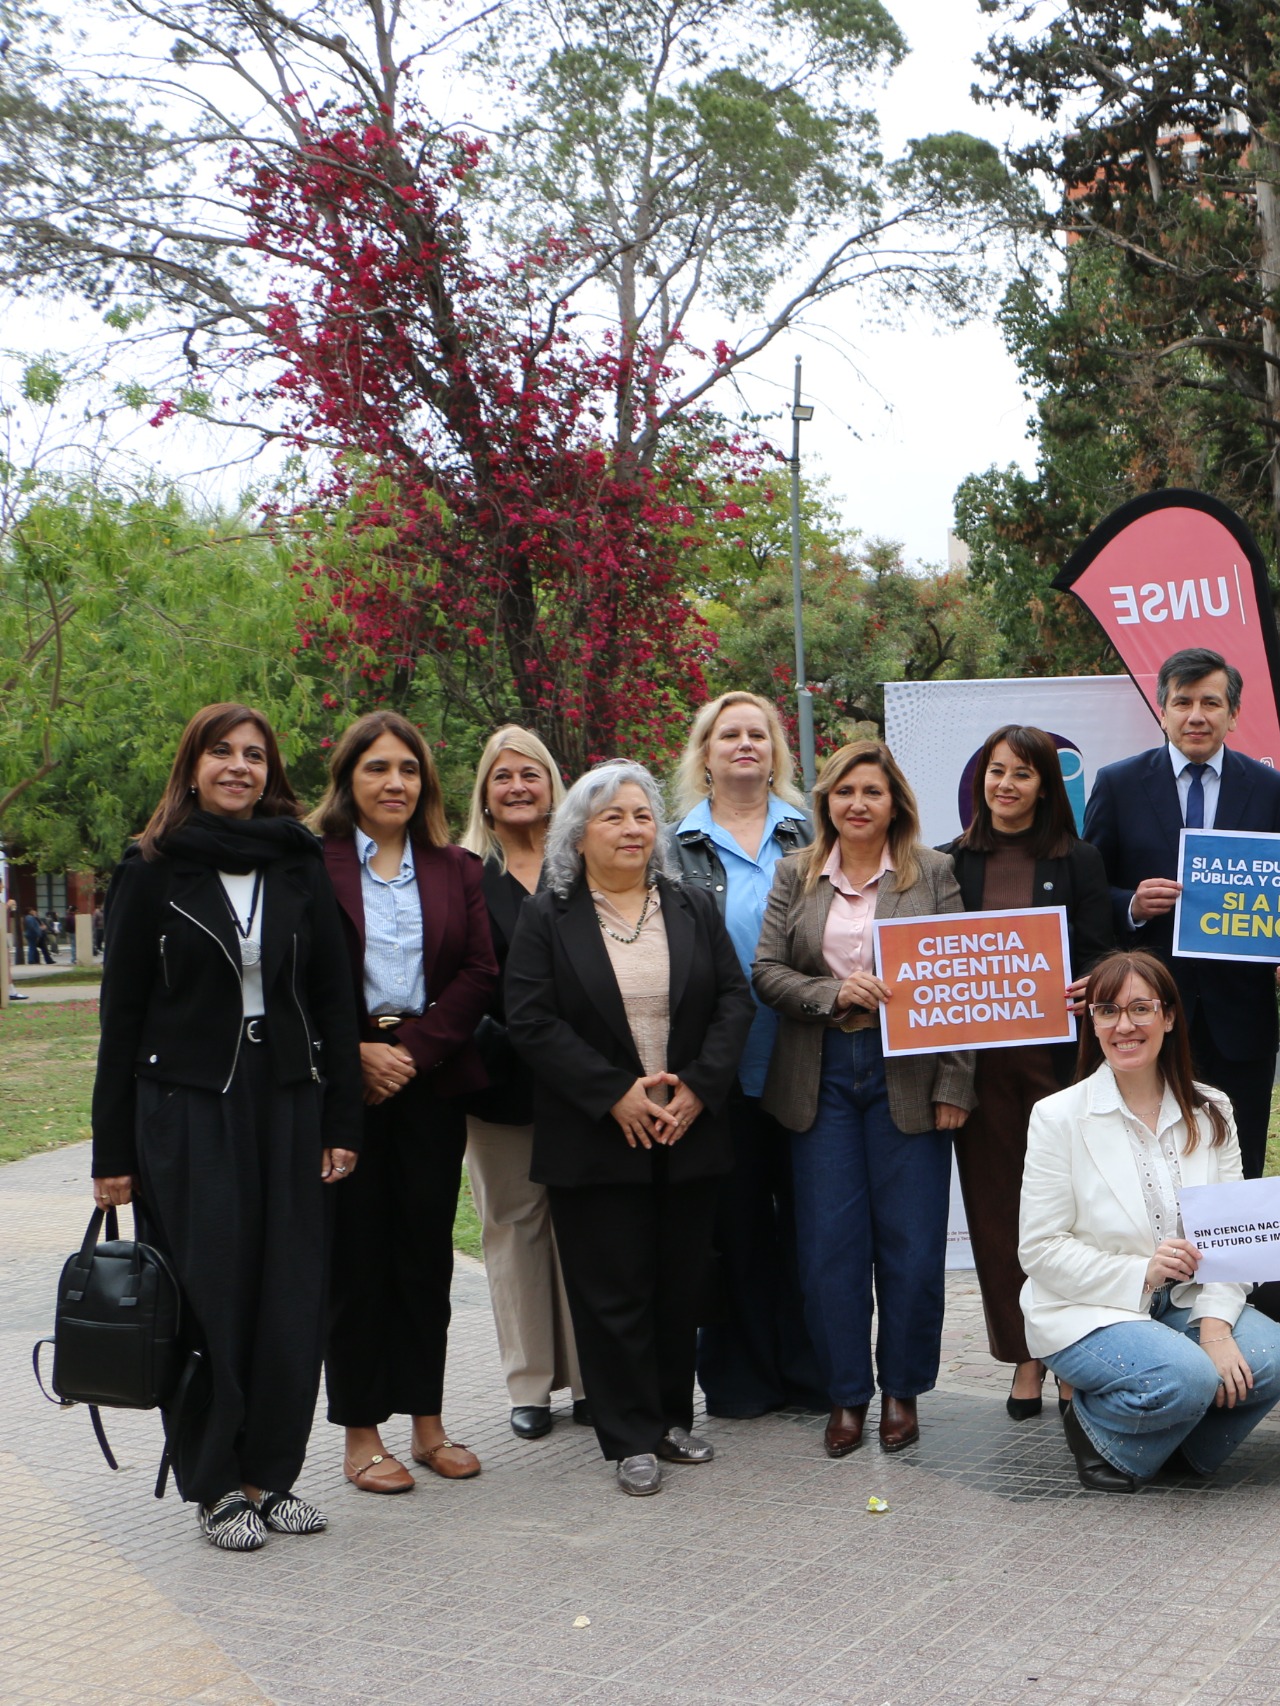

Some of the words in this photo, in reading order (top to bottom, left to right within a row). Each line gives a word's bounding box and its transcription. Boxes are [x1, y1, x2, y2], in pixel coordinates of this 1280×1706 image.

[1192, 857, 1207, 870] SI
[1210, 858, 1224, 871] A
[1227, 859, 1248, 872] LA
[1191, 869, 1254, 887] PÚBLICA
[1258, 875, 1269, 887] Y
[1222, 892, 1244, 911] SI
[1251, 894, 1270, 912] A
[917, 931, 1025, 956] CIENCIA
[896, 952, 1051, 982] ARGENTINA
[913, 978, 1037, 1005] ORGULLO
[908, 1000, 1045, 1028] NACIONAL
[1194, 1229, 1212, 1238] SIN
[1213, 1224, 1256, 1236] CIENCIA
[1196, 1241, 1209, 1250] EL
[1211, 1236, 1253, 1248] FUTURO
[1254, 1234, 1268, 1243] SE
